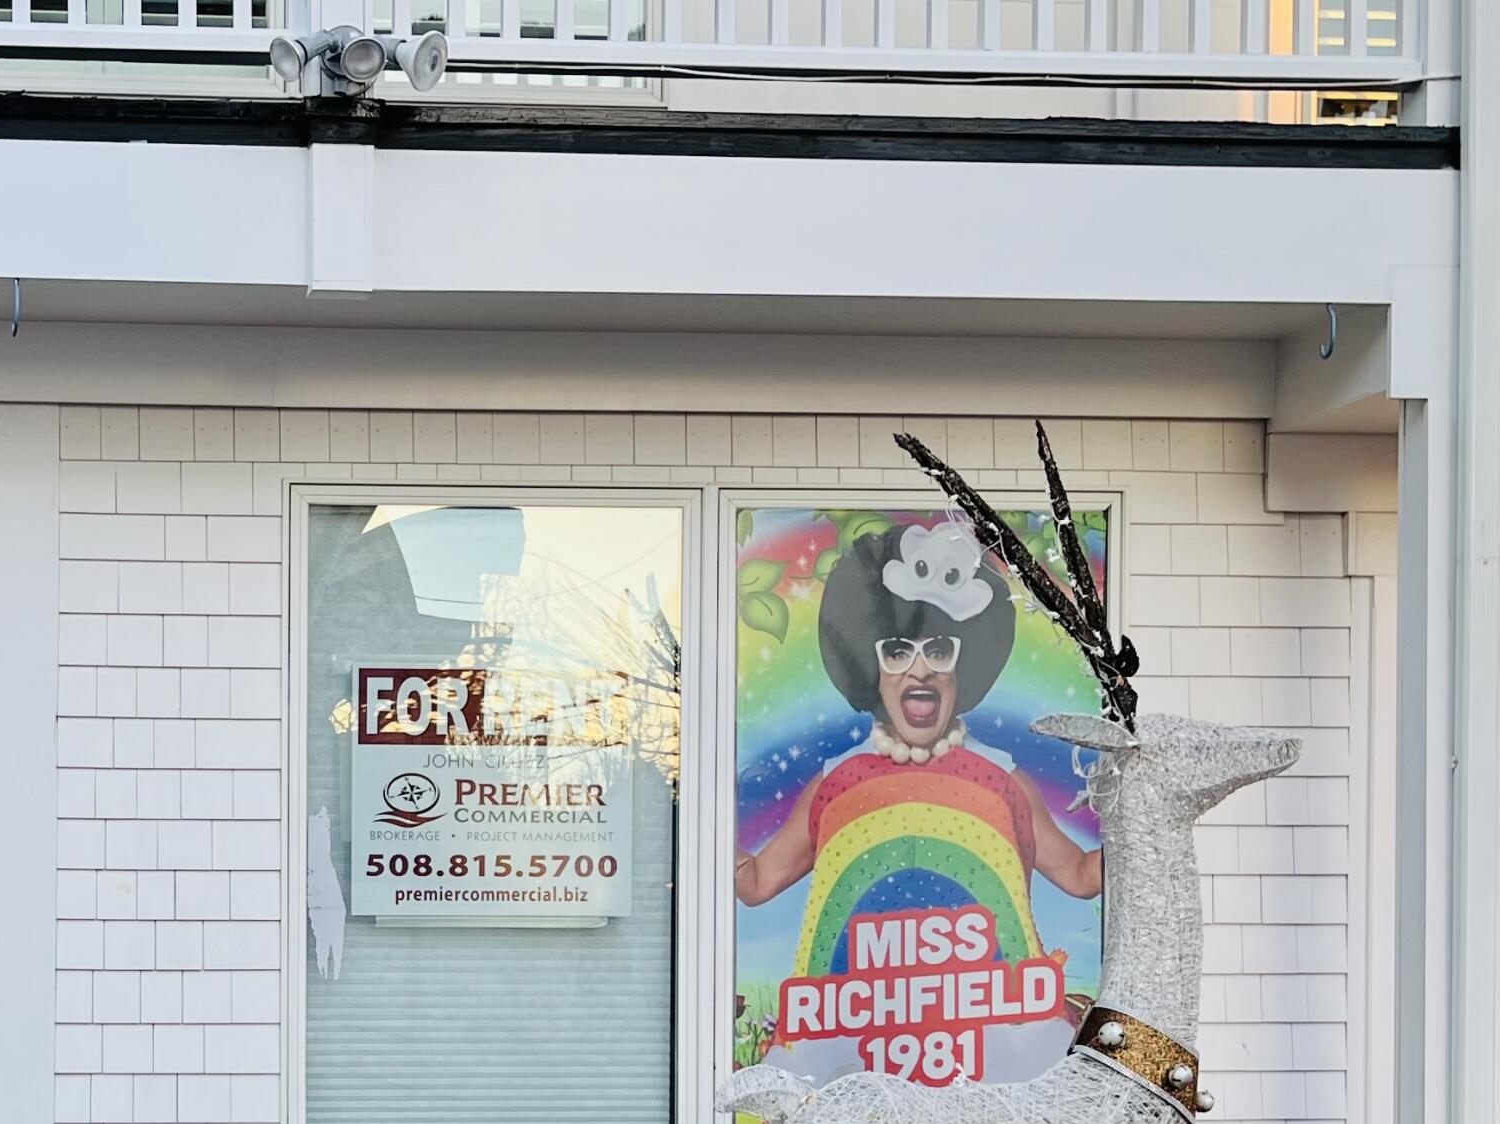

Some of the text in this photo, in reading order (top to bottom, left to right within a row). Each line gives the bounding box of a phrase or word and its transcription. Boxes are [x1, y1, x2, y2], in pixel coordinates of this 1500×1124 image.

[366, 676, 470, 737] FOR
[423, 753, 474, 769] JOHN
[454, 778, 608, 806] PREMIER
[454, 808, 608, 824] COMMERCIAL
[369, 831, 614, 842] BROKERAGE PROJECT MANAGEMENT
[366, 853, 618, 878] 508.815.5700
[394, 886, 588, 905] premiercommercial.biz
[855, 913, 990, 970] MISS
[786, 966, 1057, 1034] RICHFIELD
[866, 1030, 976, 1080] 1981
